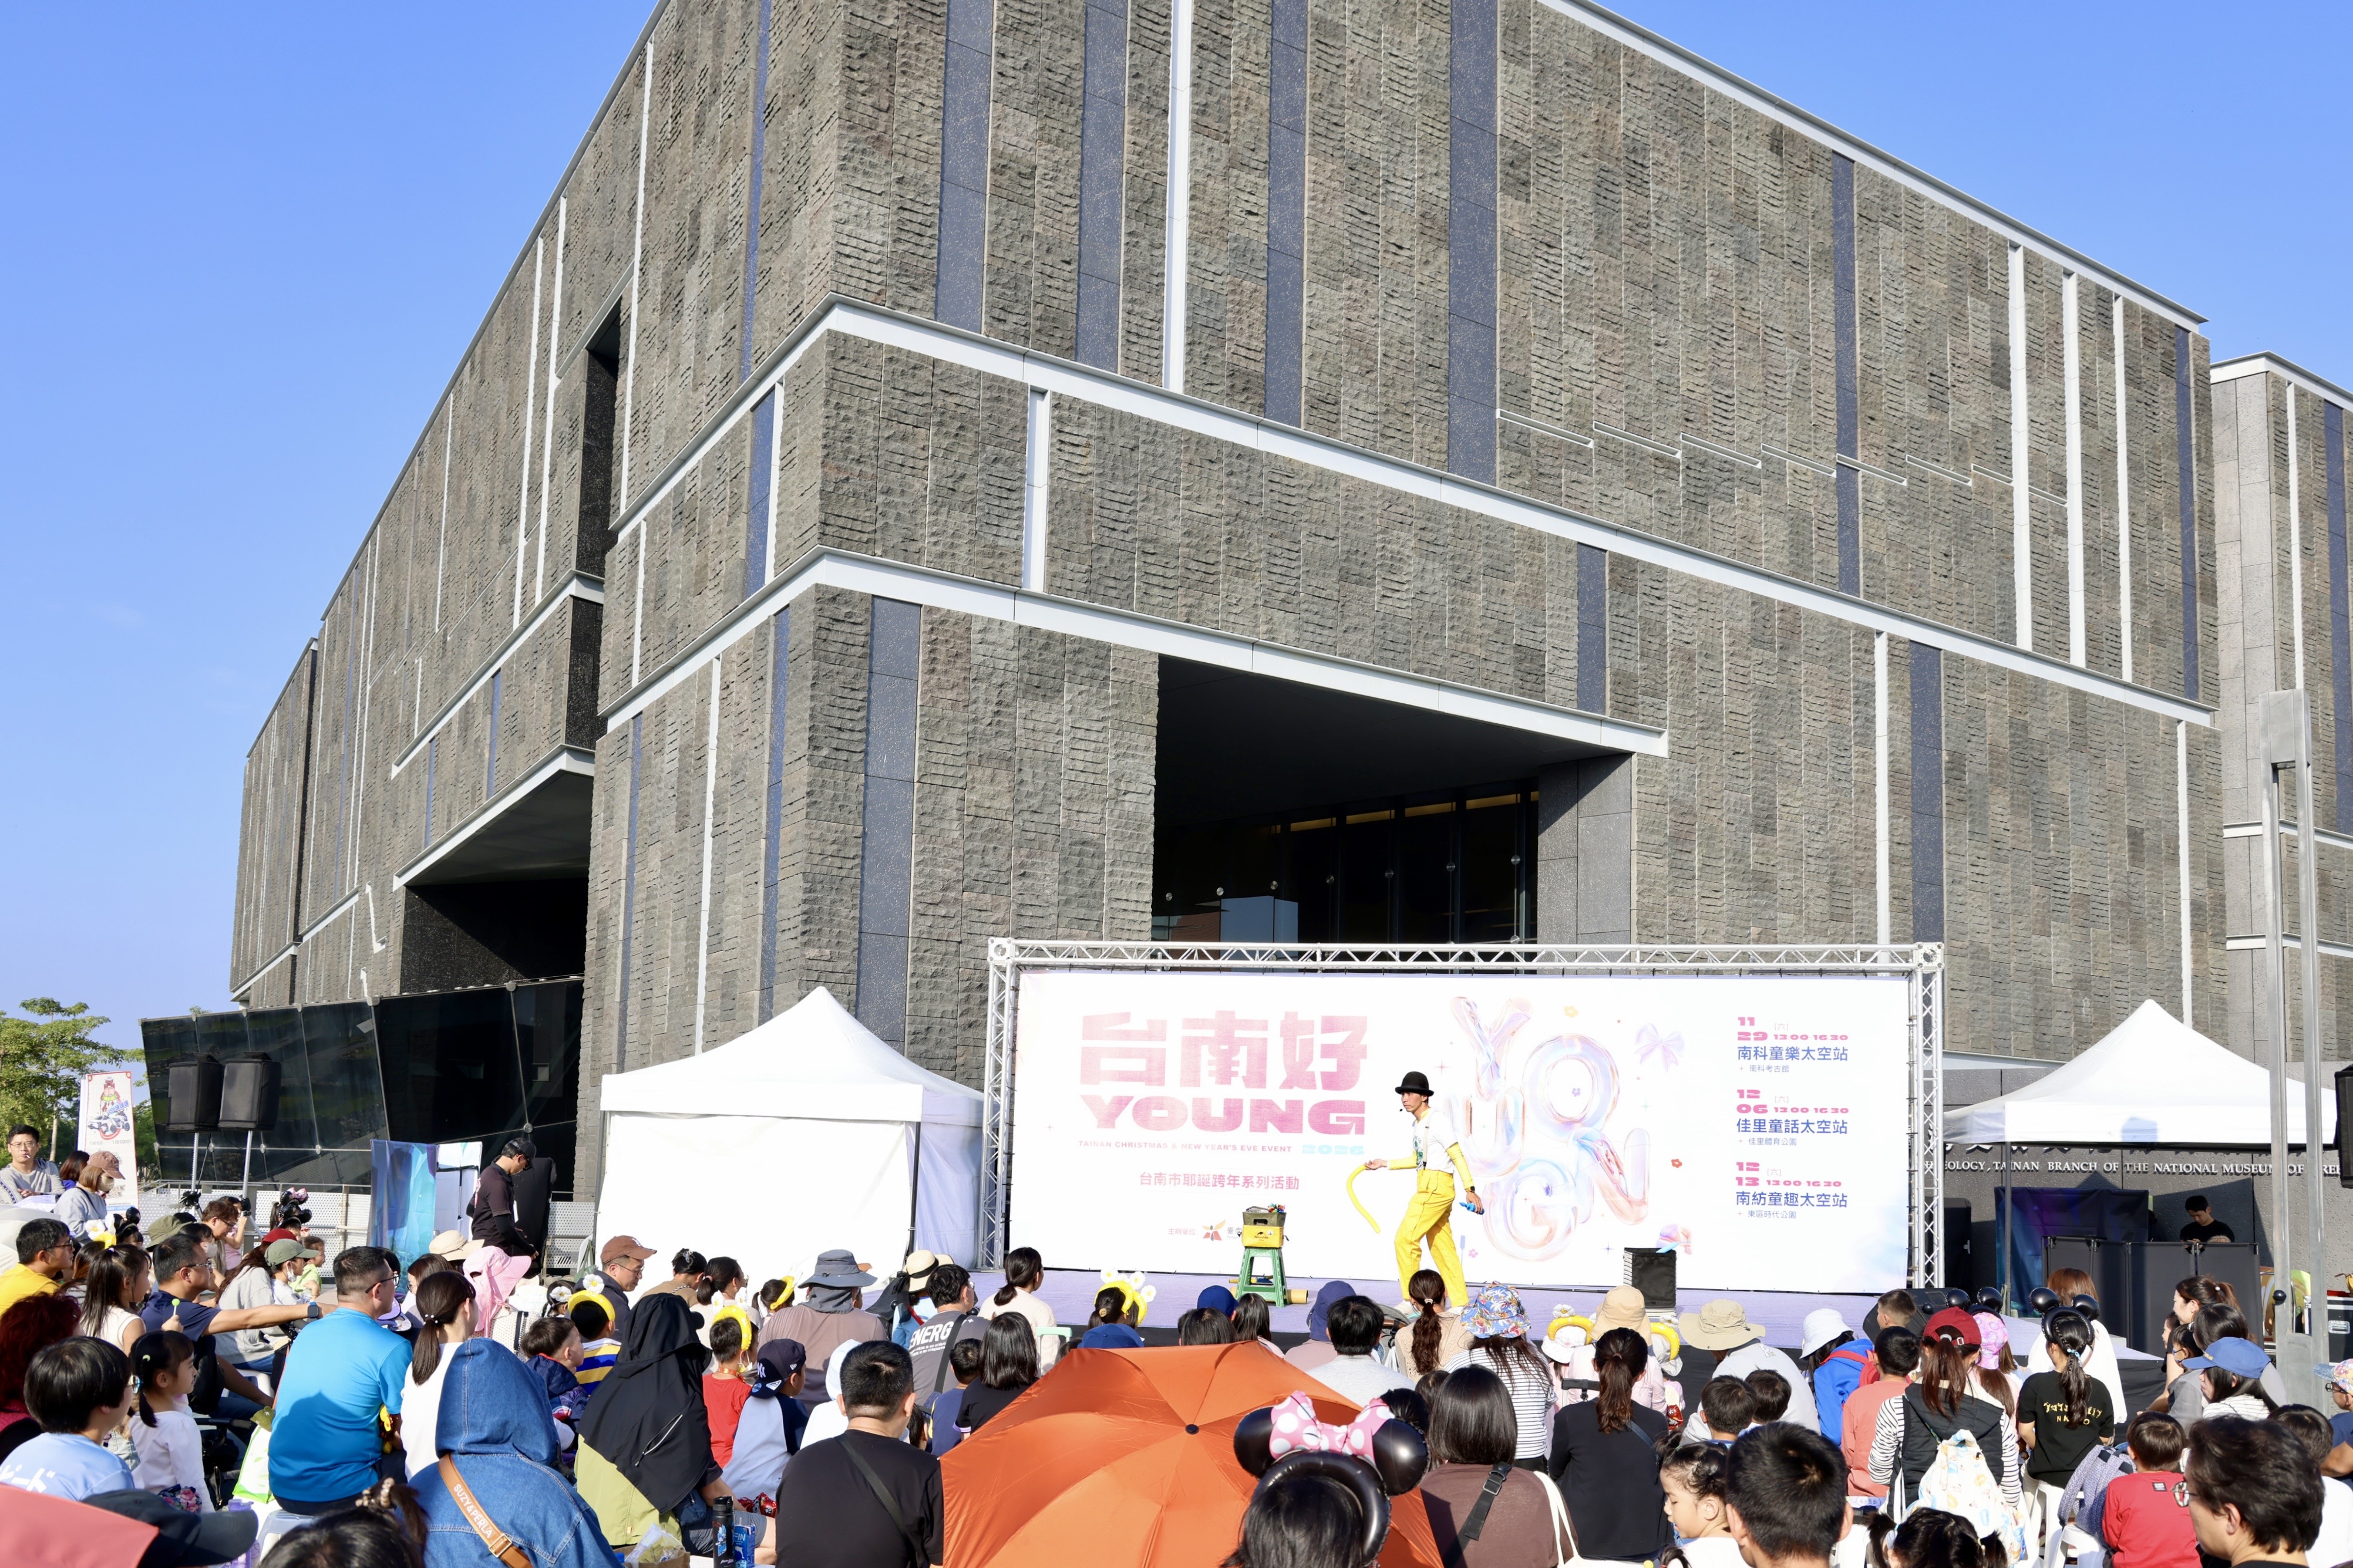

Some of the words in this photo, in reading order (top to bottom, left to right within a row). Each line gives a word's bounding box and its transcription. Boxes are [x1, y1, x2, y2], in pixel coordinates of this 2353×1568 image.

[1738, 1017, 1755, 1026] 11
[1738, 1031, 1768, 1041] 29
[1080, 1010, 1367, 1091] 台南好
[1737, 1046, 1848, 1061] 南科童樂太空站
[1749, 1064, 1789, 1073] 南科考古館
[1737, 1089, 1760, 1099] 12
[1736, 1104, 1768, 1114] 06
[1080, 1095, 1365, 1135] YOUNG
[1736, 1118, 1848, 1134] 佳里童話太空站
[1748, 1137, 1797, 1146] 佳里體育公園
[1302, 1144, 1365, 1155] 2026
[1736, 1162, 1760, 1172] 12
[2048, 1162, 2098, 1171] BRANCH
[2103, 1162, 2119, 1172] OF
[2124, 1162, 2149, 1172] THE
[2153, 1163, 2218, 1173] NATIONAL
[2222, 1164, 2272, 1174] MUSEU
[2288, 1164, 2304, 1174] OF
[1140, 1172, 1300, 1190] 台南市耶誕跨年系列活動
[1735, 1176, 1760, 1186] 13
[1736, 1191, 1848, 1208] 南紡童趣太空站
[1748, 1210, 1796, 1219] 東區時代公園
[453, 1483, 493, 1538] SUZY&PERLA
